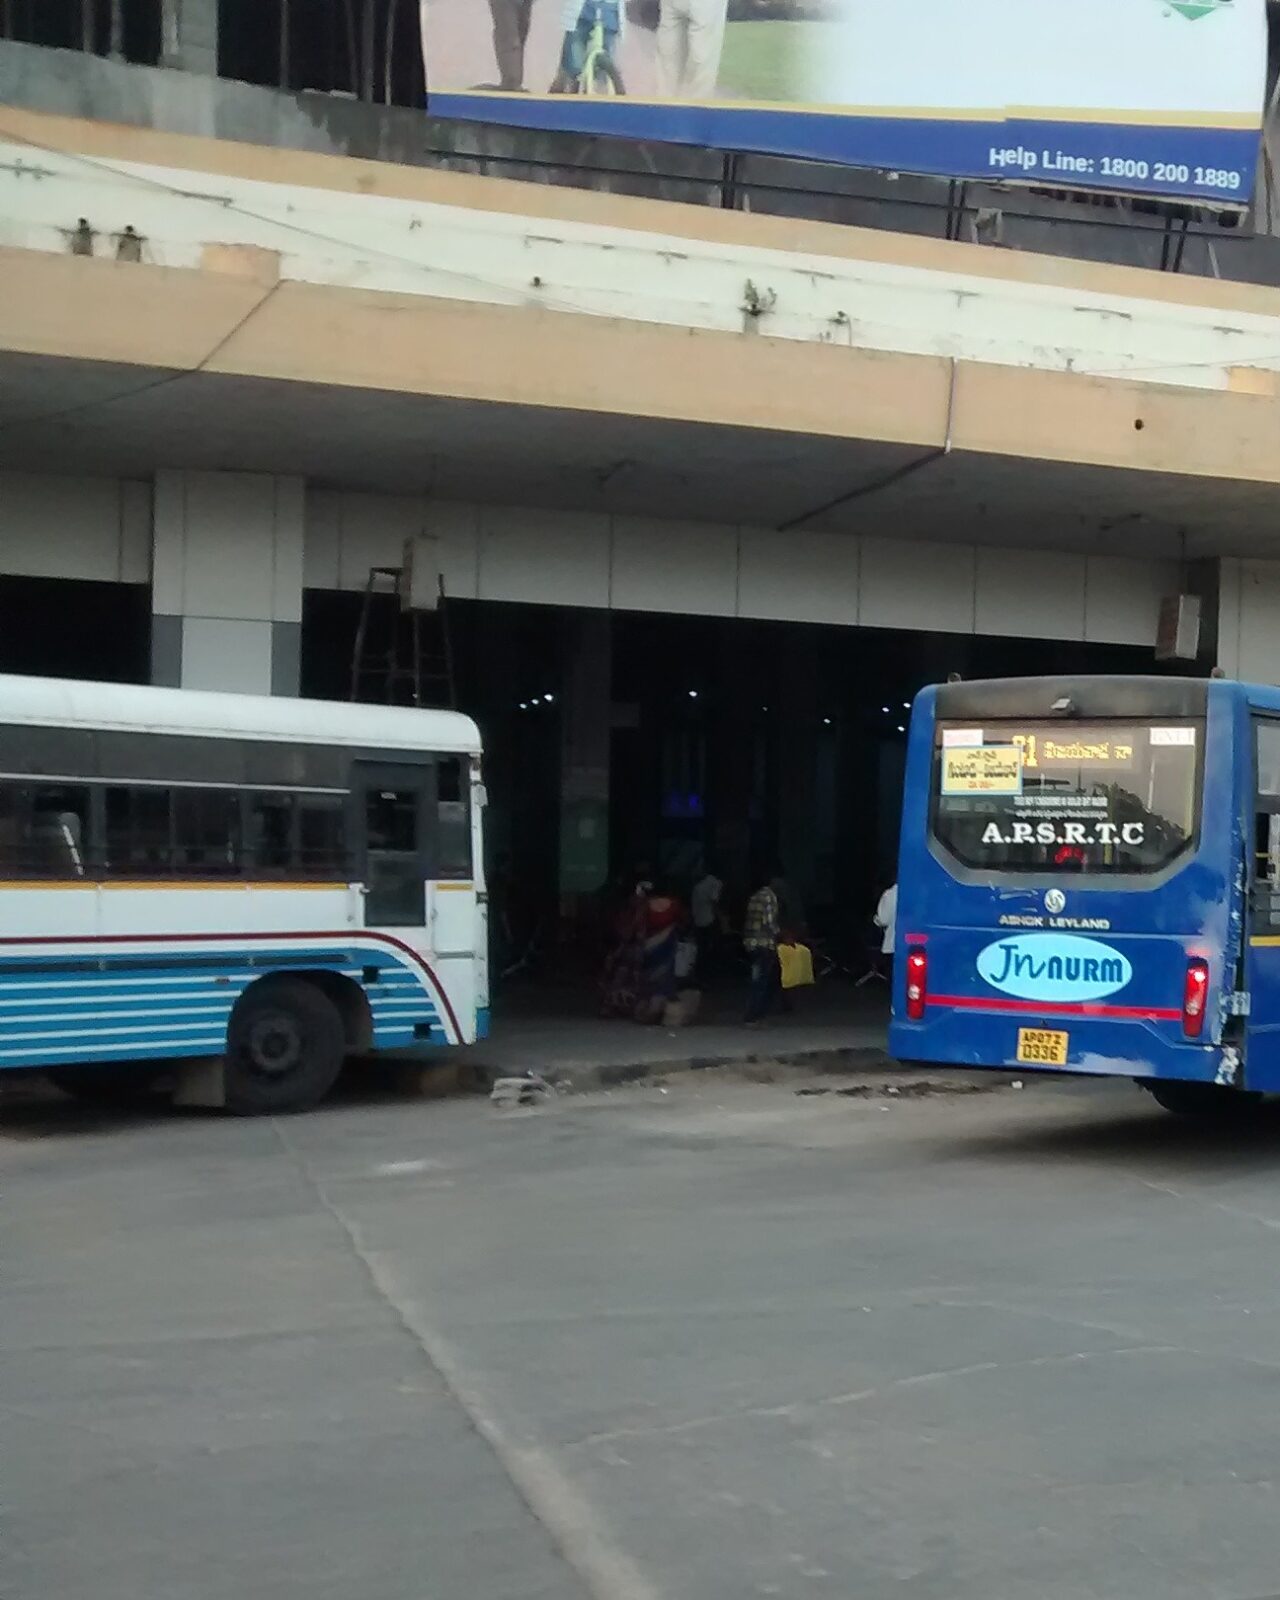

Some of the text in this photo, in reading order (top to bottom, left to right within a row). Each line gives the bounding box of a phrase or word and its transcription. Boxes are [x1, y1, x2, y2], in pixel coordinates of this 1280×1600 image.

[989, 146, 1241, 190] Help Line: 1800 200 1889
[999, 914, 1110, 930] ASHOK LEYLAND
